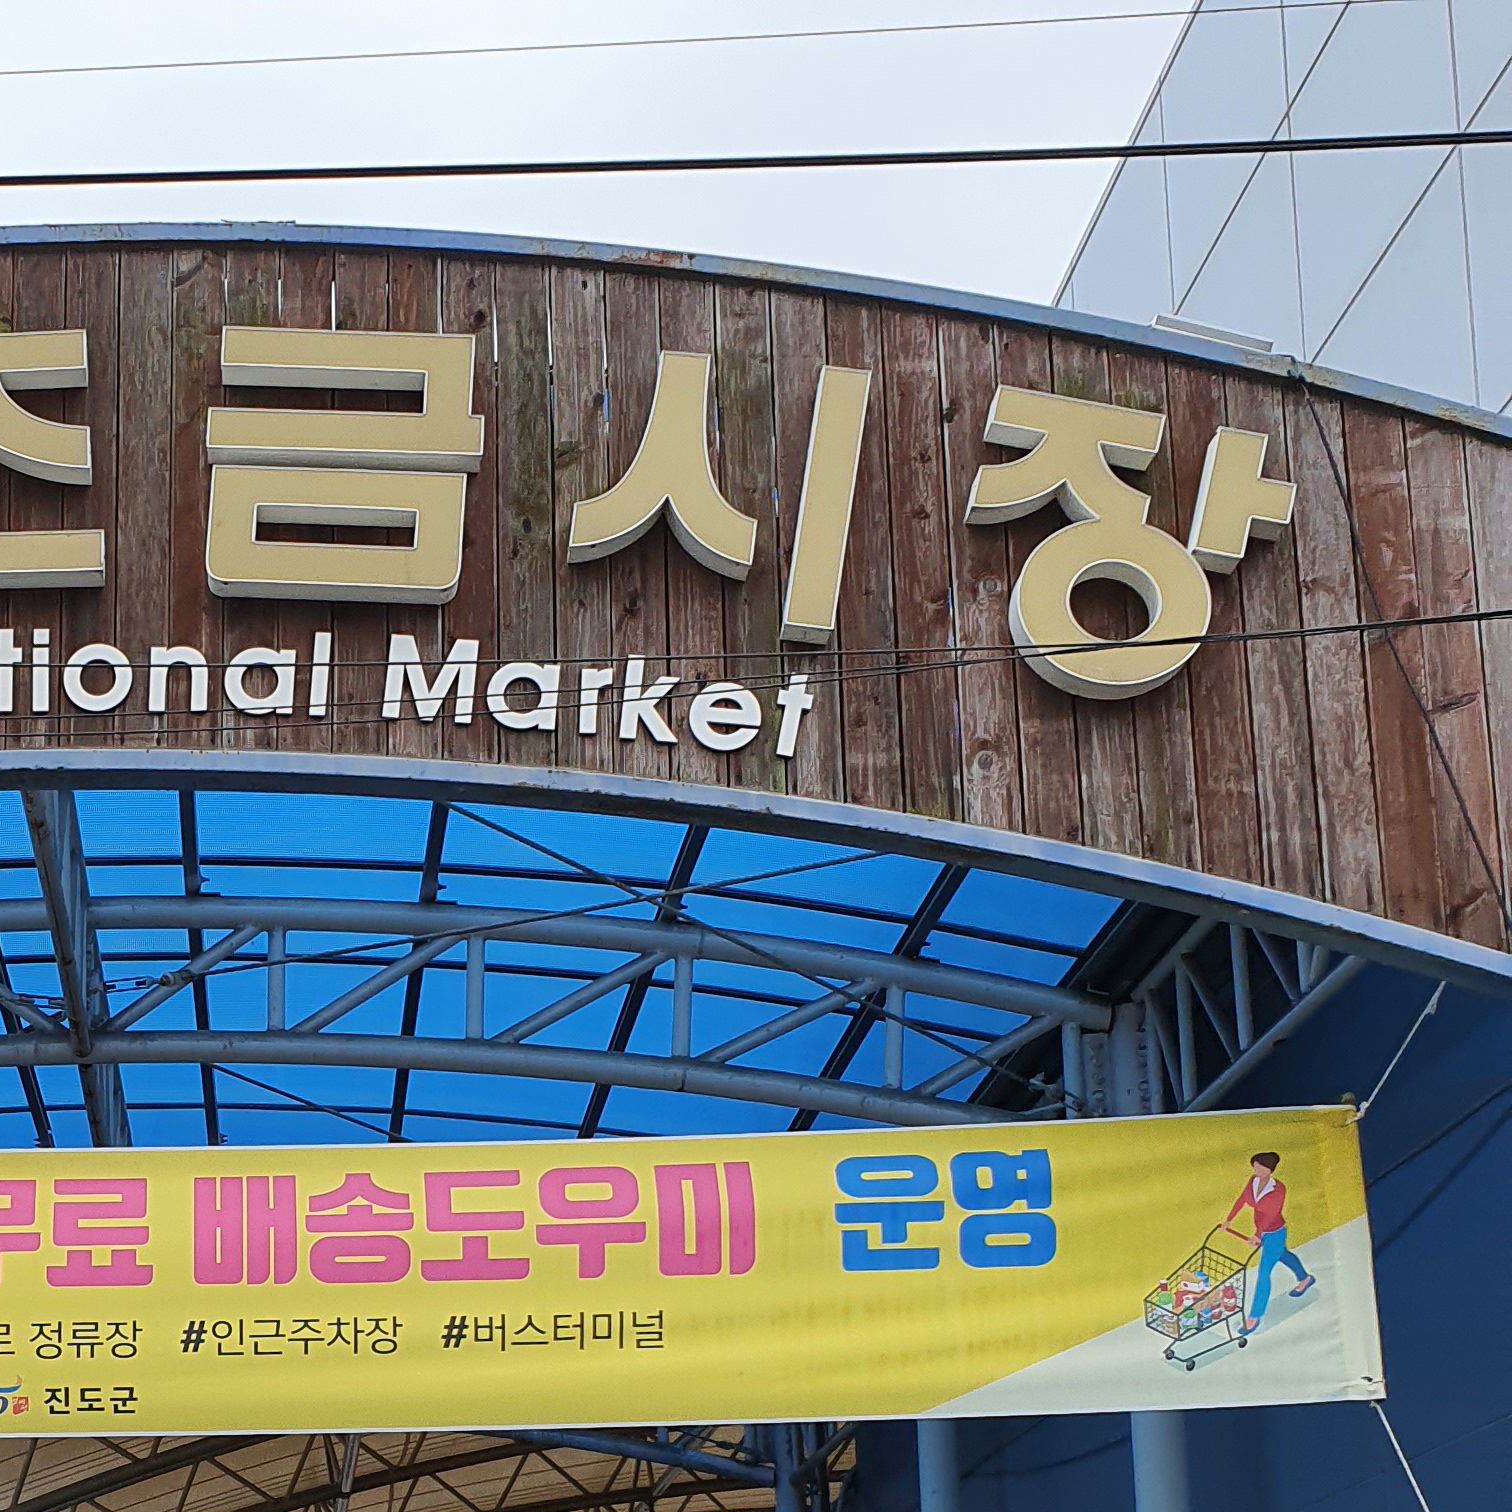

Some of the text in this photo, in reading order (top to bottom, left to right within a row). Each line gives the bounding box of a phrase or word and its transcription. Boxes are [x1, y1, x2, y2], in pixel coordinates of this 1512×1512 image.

[381, 632, 814, 758] Market
[193, 1160, 756, 1285] 배송도우미
[835, 1147, 1054, 1274] 운영
[28, 1318, 144, 1360] 정류장
[179, 1314, 404, 1356] #인근주차장
[440, 1308, 667, 1352] #버스터미널
[43, 1384, 139, 1416] 진도군
